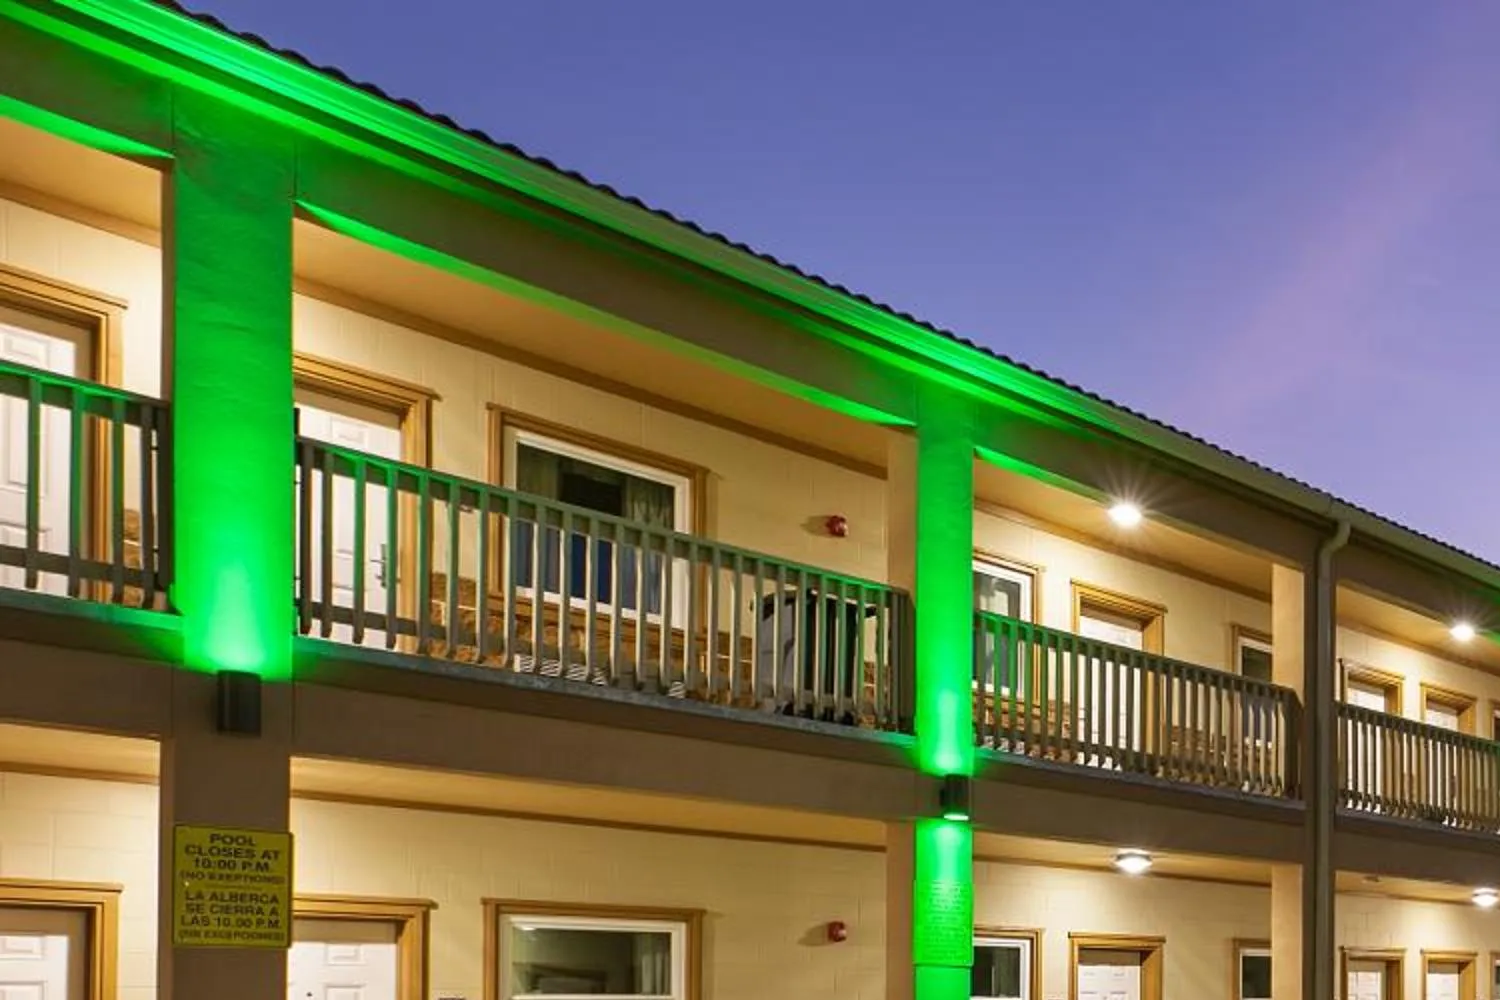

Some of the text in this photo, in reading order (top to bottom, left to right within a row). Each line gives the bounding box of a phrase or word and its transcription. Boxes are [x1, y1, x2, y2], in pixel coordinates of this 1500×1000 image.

[209, 833, 256, 846] POOL
[185, 844, 280, 860] CLOSES AT
[194, 858, 236, 870] 10:00
[185, 890, 280, 905] LA ALBERCA
[185, 903, 280, 916] SE CIERRA A
[181, 915, 210, 927] LAS
